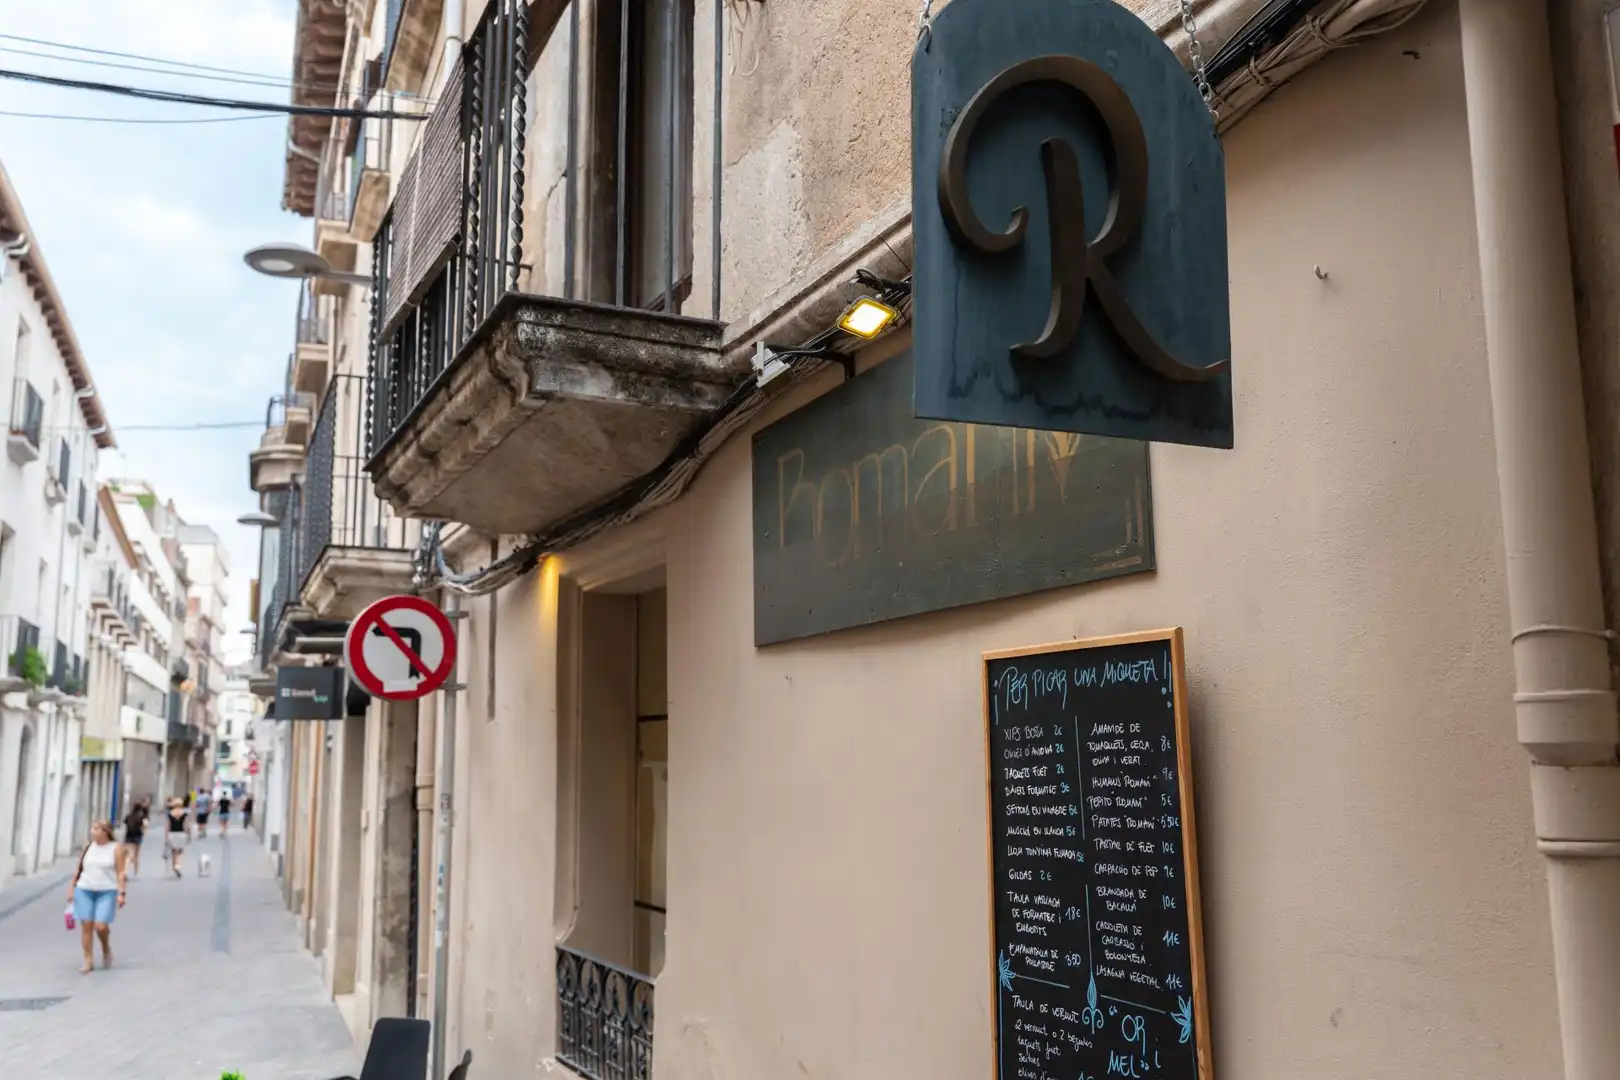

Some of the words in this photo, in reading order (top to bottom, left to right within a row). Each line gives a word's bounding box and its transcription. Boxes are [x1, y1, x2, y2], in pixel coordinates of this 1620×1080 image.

[937, 53, 1228, 384] R
[1032, 668, 1068, 710] PICAR
[1074, 666, 1097, 689] UNA
[1003, 726, 1021, 742] XIPS
[1053, 724, 1063, 736] 2€
[1129, 722, 1141, 734] DE
[1054, 743, 1065, 754] 2€
[1160, 735, 1172, 752] 8€
[1032, 765, 1048, 777] FUET
[1055, 763, 1065, 775] 2€
[1161, 766, 1173, 781] 9€
[1161, 793, 1173, 807] 5€
[1031, 805, 1041, 815] EN
[1126, 840, 1135, 852] DE
[1161, 840, 1175, 854] 10€
[1008, 868, 1033, 881] GILDAS
[1040, 869, 1052, 881] 2€
[1131, 865, 1142, 876] DE
[1163, 864, 1175, 878] 9€
[1006, 889, 1030, 905] TAULA
[1138, 889, 1148, 899] DE
[1161, 894, 1176, 910] 10€
[1011, 907, 1021, 918] DE
[1064, 906, 1081, 921] 18€
[1132, 924, 1143, 936] DE
[1162, 929, 1180, 947] 11€
[1050, 949, 1060, 959] DE
[1096, 964, 1126, 979] LASAGNA
[1012, 994, 1035, 1011] TAULA
[1039, 1003, 1049, 1014] DE
[1051, 1006, 1080, 1024] VERMUT
